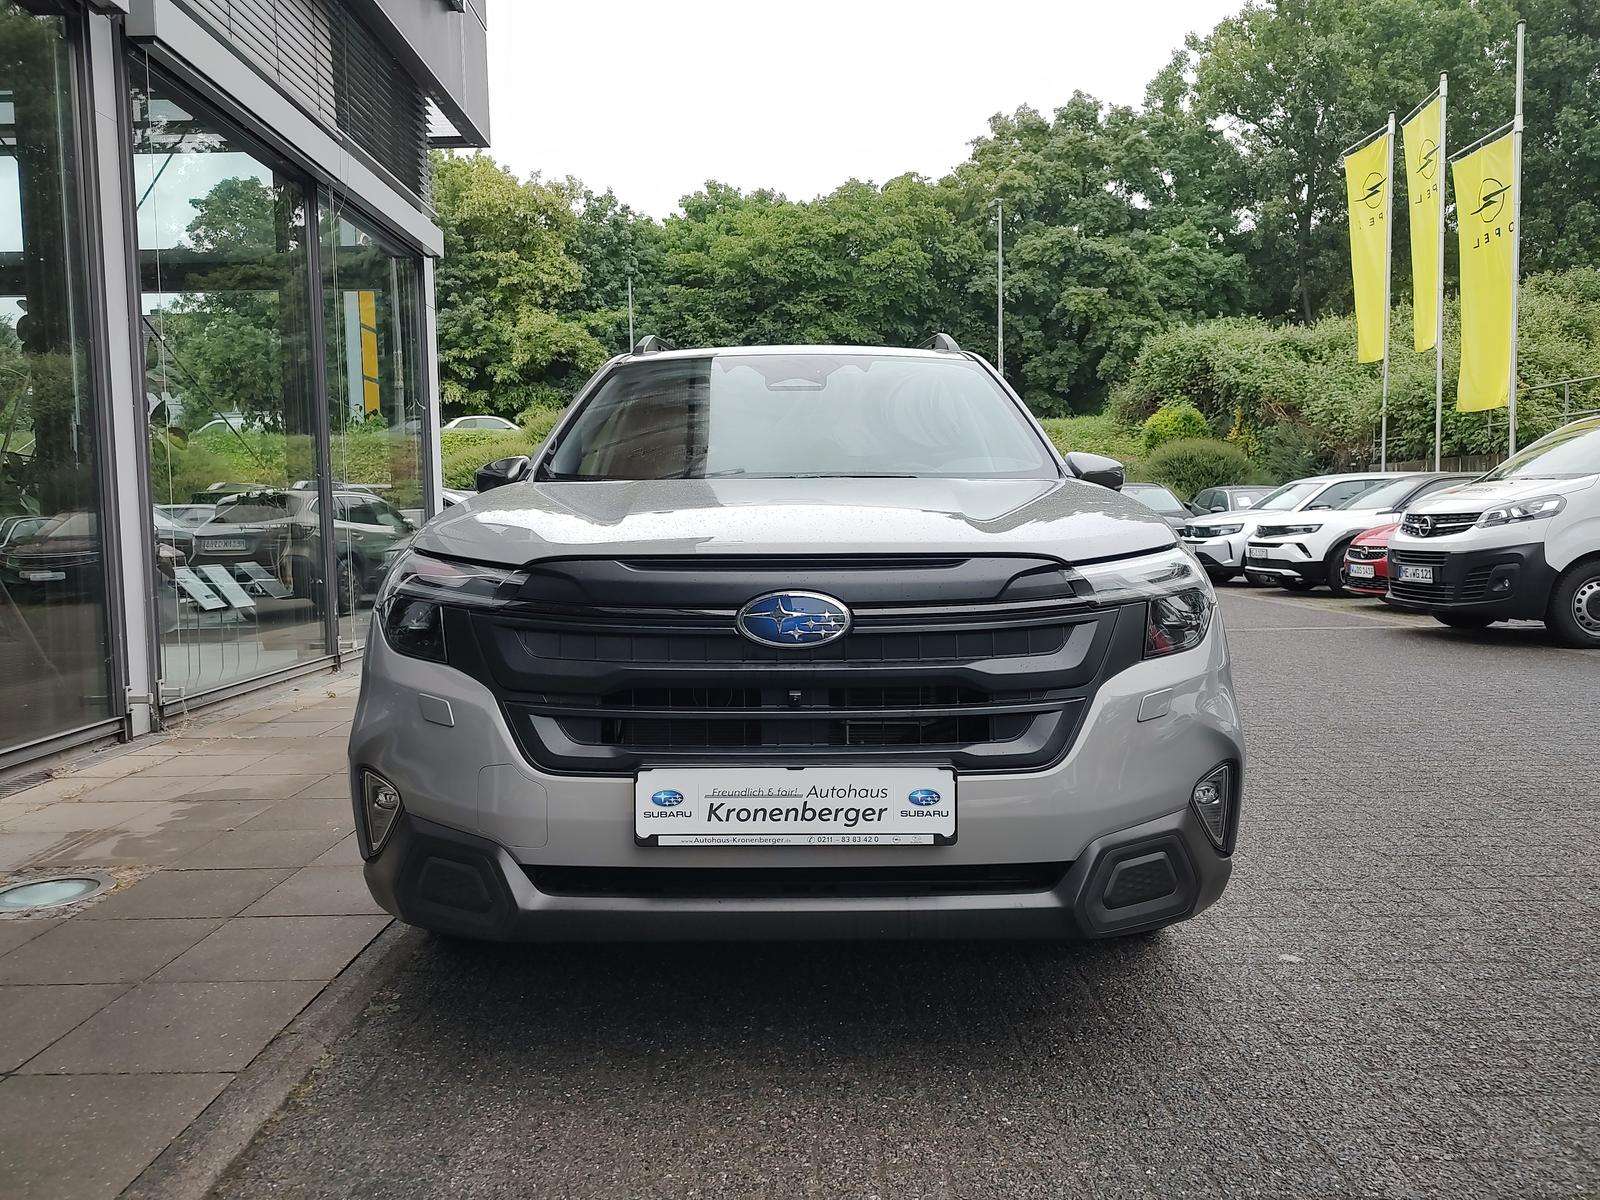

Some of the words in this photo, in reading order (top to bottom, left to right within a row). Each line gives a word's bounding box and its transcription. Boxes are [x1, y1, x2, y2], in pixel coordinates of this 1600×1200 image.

[711, 787, 764, 797] Freundlich
[767, 788, 774, 797] &
[776, 787, 798, 798] fair!
[806, 784, 888, 799] Autohaus
[643, 810, 692, 819] SUBARU
[707, 801, 888, 828] Kronenberger
[900, 810, 949, 818] SUBARU
